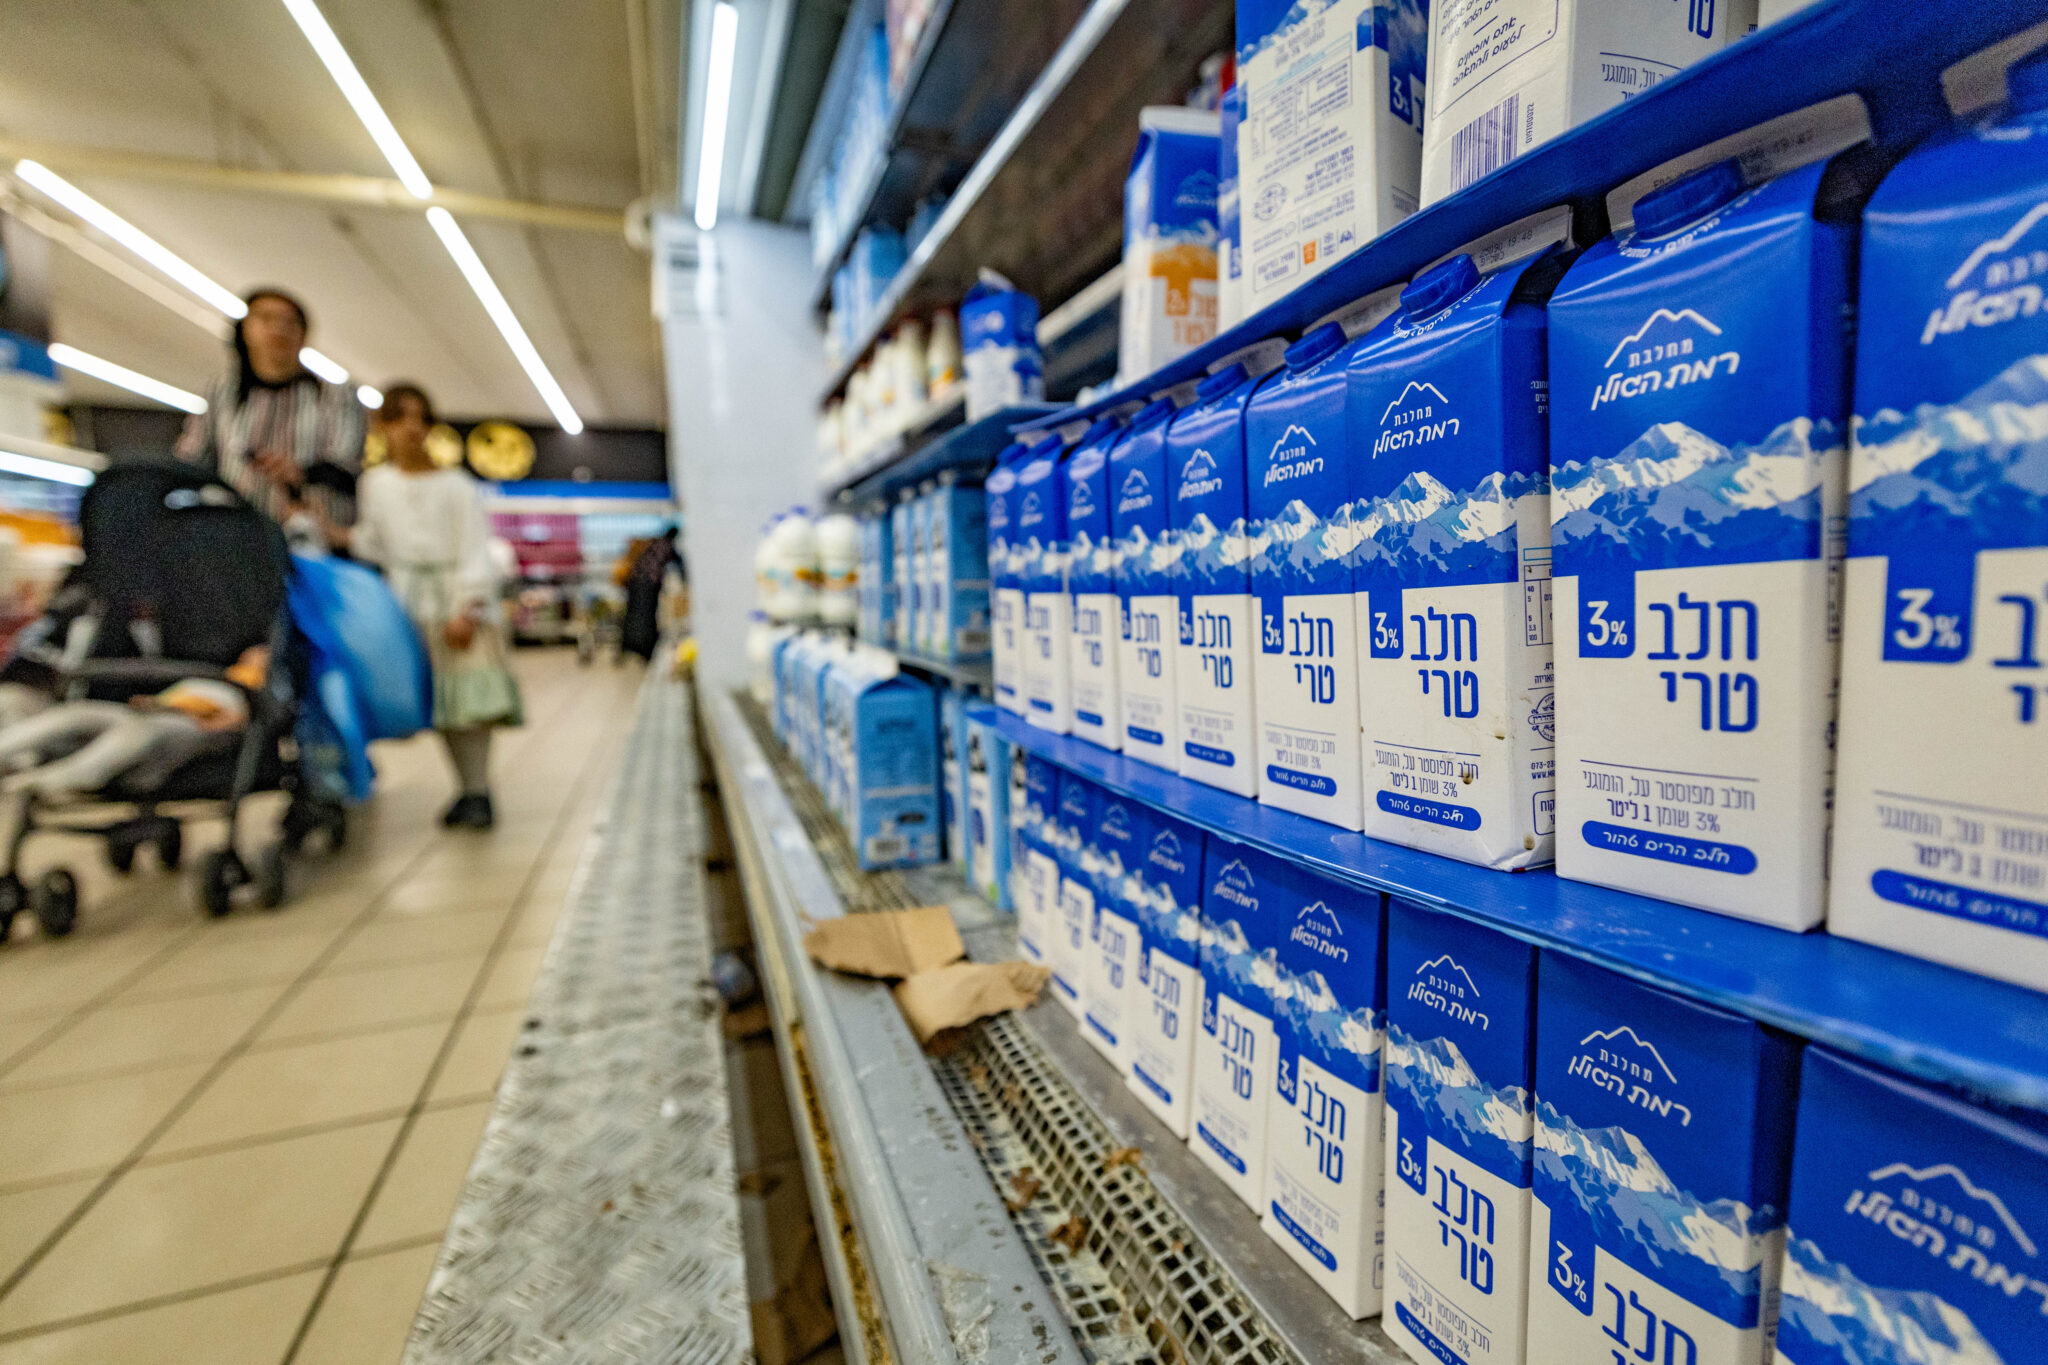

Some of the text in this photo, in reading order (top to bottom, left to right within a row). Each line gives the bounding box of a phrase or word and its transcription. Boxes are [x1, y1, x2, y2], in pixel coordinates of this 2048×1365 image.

[1493, 16, 1516, 40] אתם
[1602, 63, 1637, 86] הומוגני
[1628, 338, 1694, 368] מחלבת
[1591, 351, 1739, 411] רמת הגולן
[1394, 406, 1432, 427] מחלבת
[1373, 418, 1460, 460] רמת הגולן
[1264, 458, 1324, 488] רמת הגולן
[1198, 610, 1231, 648] חלב
[1264, 615, 1281, 646] 3%
[1289, 612, 1334, 657] חלב
[1374, 612, 1398, 649] 3%
[1410, 606, 1477, 662] חלב
[1587, 600, 1628, 646] 3%
[1647, 592, 1758, 661] חלב
[1895, 588, 1962, 649] 3%
[1202, 654, 1233, 688] טרי
[1295, 664, 1335, 704] טרי
[1418, 669, 1479, 718] טרי
[1660, 672, 1758, 732] טרי
[1390, 772, 1458, 797] 3% שומן 1 ליטר
[1418, 757, 1454, 776] מפוסטר
[1457, 761, 1479, 780] חלב
[1584, 770, 1623, 796] הומוגני
[1388, 799, 1464, 822] חלב הרים טהור
[1656, 780, 1714, 806] מפוסטר
[1722, 786, 1756, 810] חלב
[1606, 798, 1721, 832] 3% שומן 1 ליטר
[1602, 831, 1730, 864] חלב הרים טהור
[1290, 925, 1349, 963] רמת הגולן
[1429, 975, 1464, 998] מחלבת
[1408, 982, 1489, 1031] רמת הגולן
[1220, 1013, 1255, 1064] חלב
[1222, 1052, 1253, 1101] טרי
[1280, 1058, 1297, 1098] 3%
[1599, 1049, 1653, 1083] מחלבת
[1301, 1079, 1345, 1141] חלב
[1568, 1055, 1692, 1127] רמת הגולן
[1305, 1125, 1344, 1184] טרי
[1401, 1137, 1422, 1185] 3%
[1432, 1165, 1494, 1245] חלב
[1438, 1219, 1493, 1295] טרי
[1555, 1240, 1586, 1303] 3%
[1435, 1298, 1467, 1337] מפוסטר
[1435, 1318, 1454, 1344] שומן
[1602, 1282, 1697, 1365] חלב
[1406, 1315, 1452, 1364] הרים טהור
[1457, 1336, 1470, 1358] 3%
[1470, 1326, 1490, 1353] חלב
